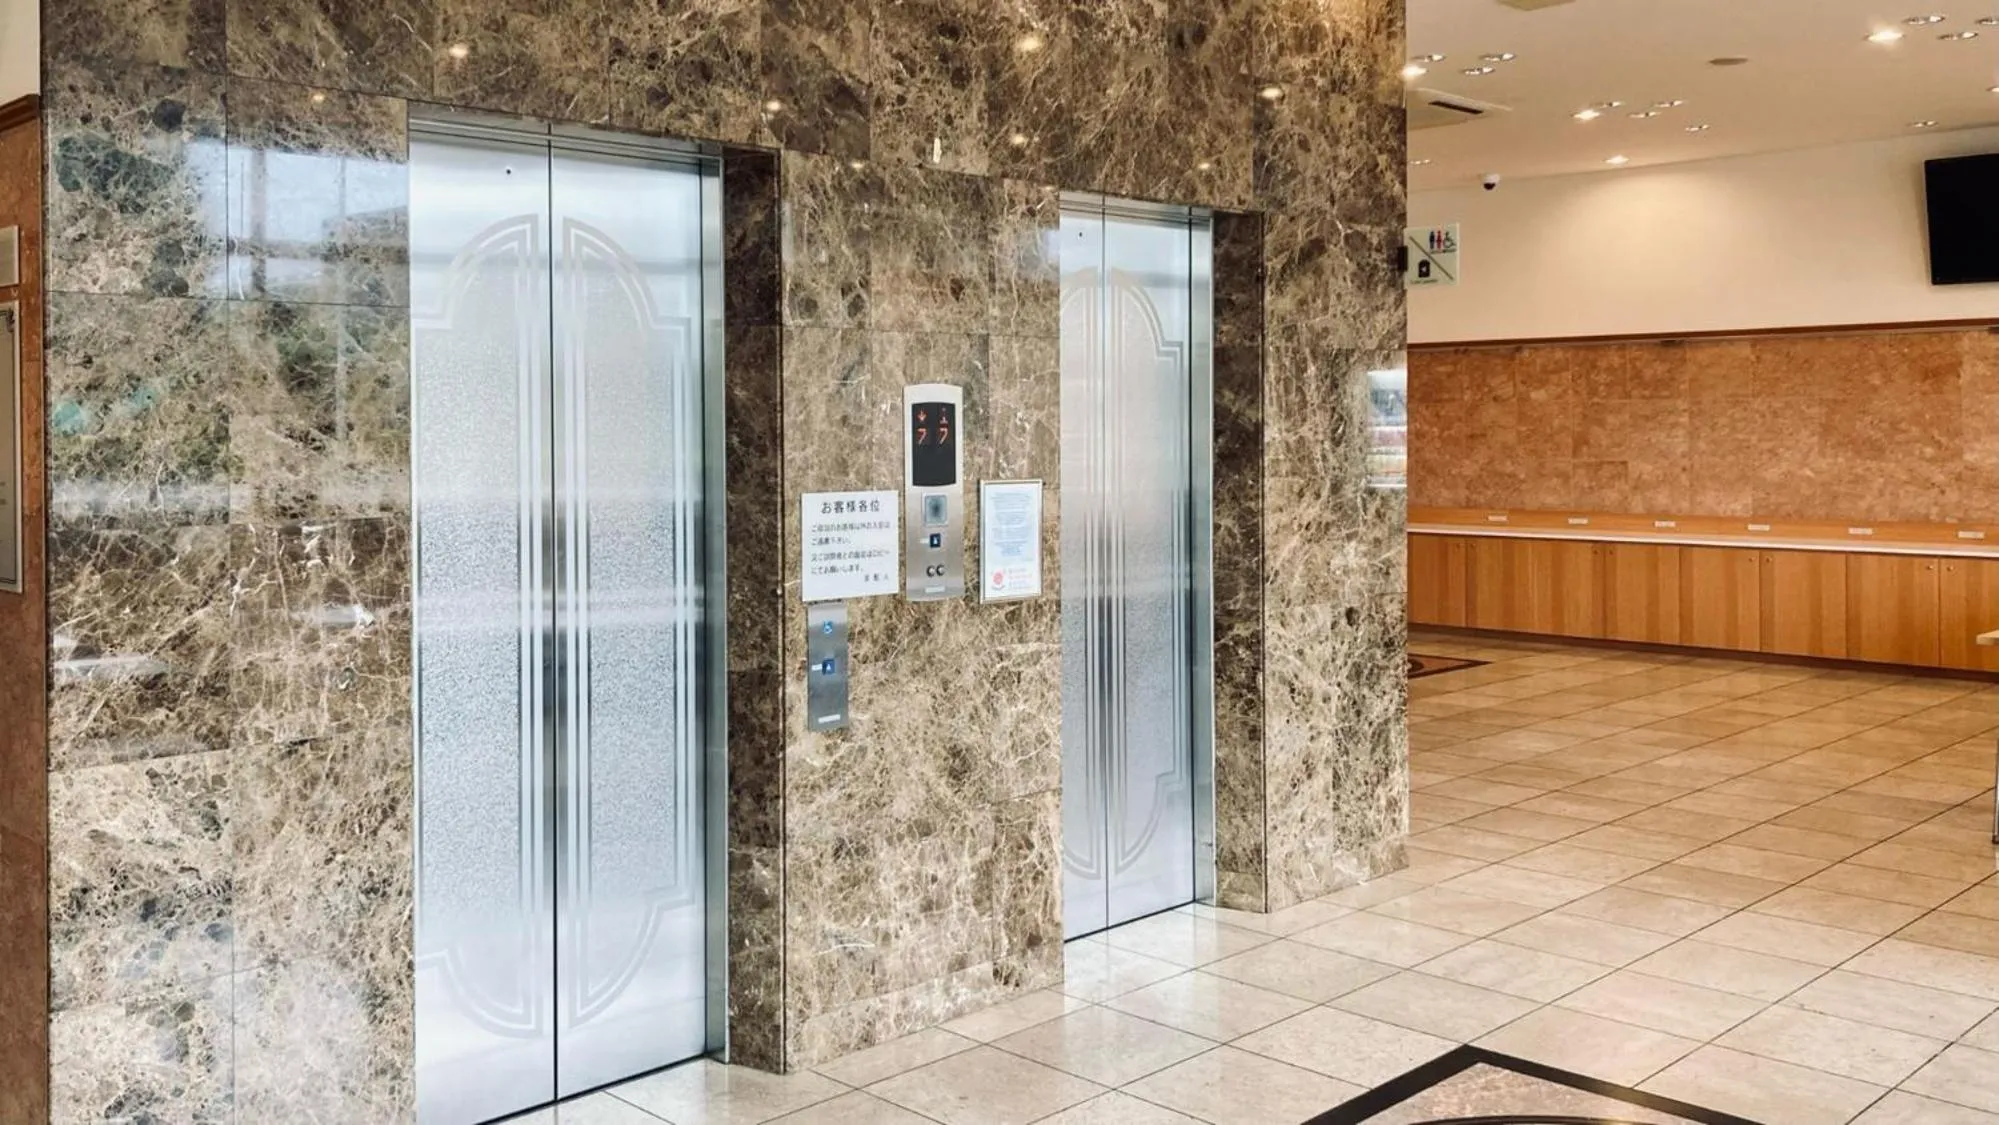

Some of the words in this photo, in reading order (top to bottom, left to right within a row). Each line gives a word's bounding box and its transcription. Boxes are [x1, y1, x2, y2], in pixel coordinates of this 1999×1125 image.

[821, 499, 881, 514] お客様各位
